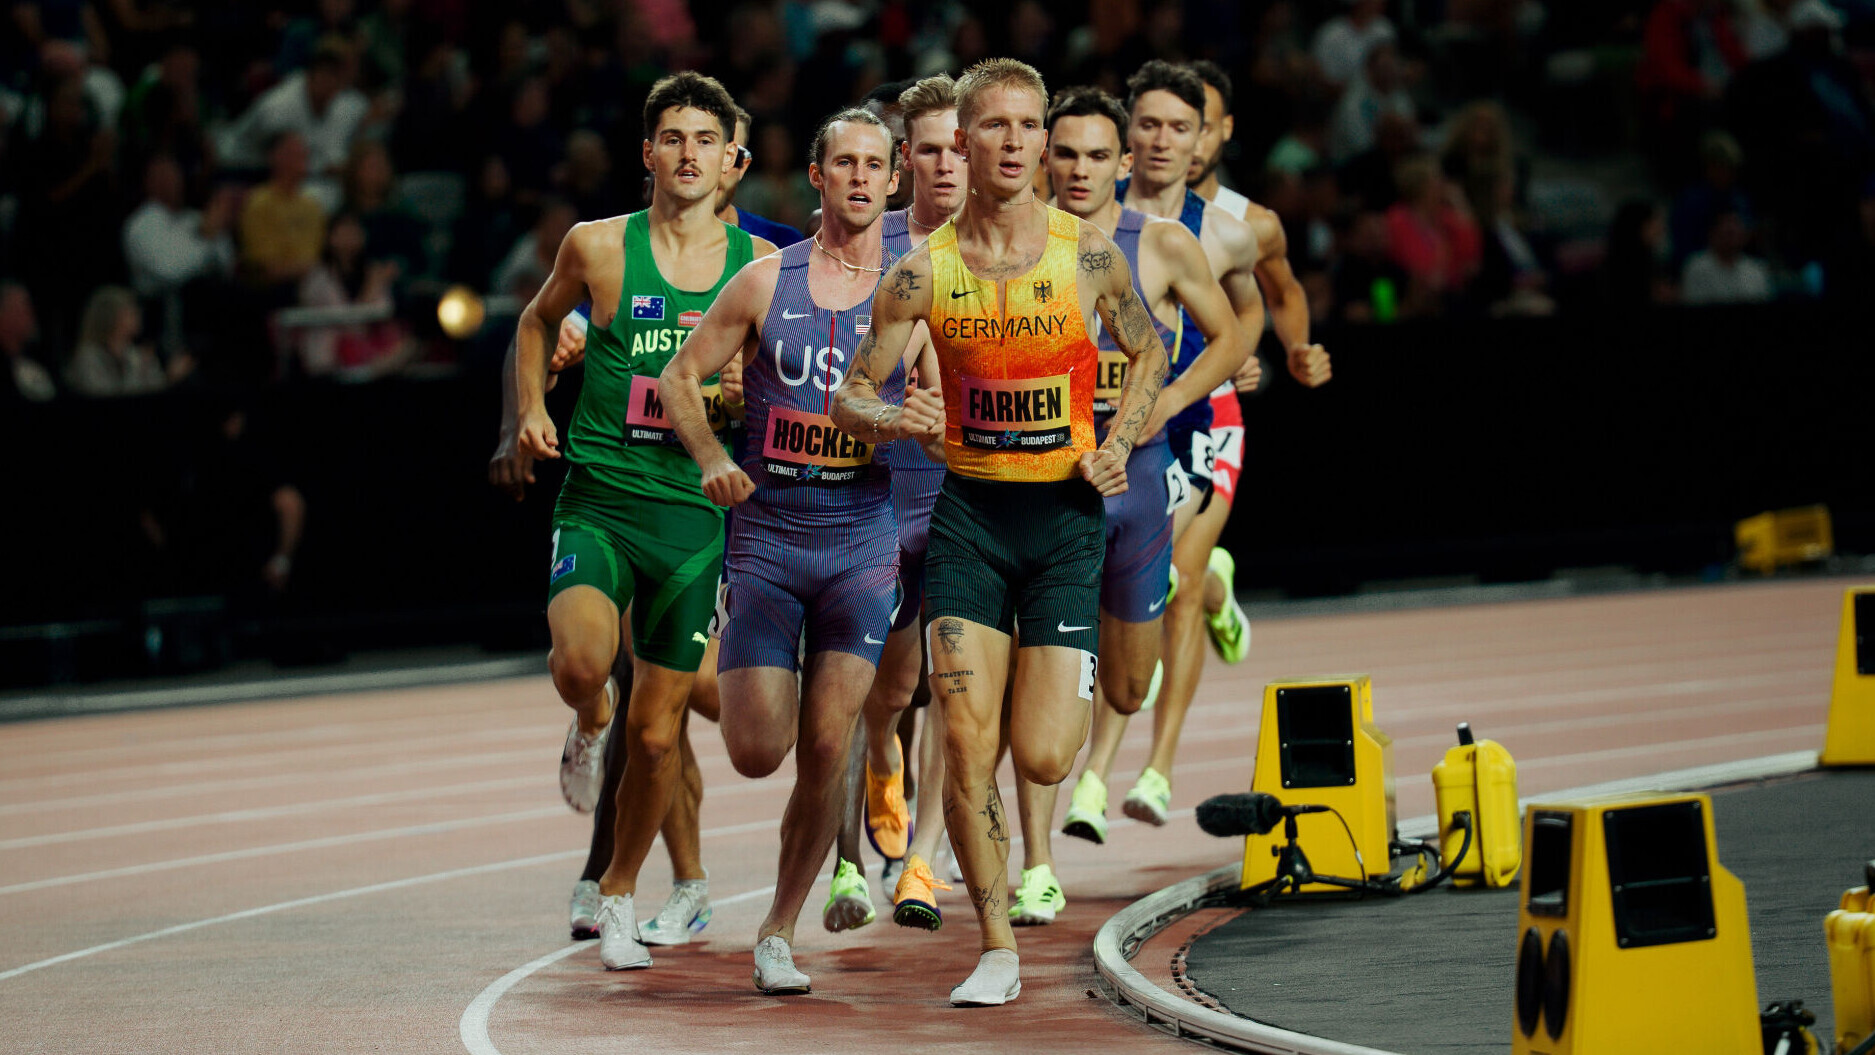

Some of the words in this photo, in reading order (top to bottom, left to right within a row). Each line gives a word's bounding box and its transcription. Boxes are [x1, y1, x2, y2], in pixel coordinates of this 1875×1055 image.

[942, 314, 1067, 338] GERMANY
[631, 328, 693, 357] AUST
[775, 339, 845, 392] US
[969, 386, 1062, 422] FARKEN
[632, 428, 664, 441] ULTIMATE
[968, 432, 997, 445] ULTIMATE
[1021, 434, 1056, 446] BUDAPEST
[767, 462, 798, 478] ULTIMATE
[821, 471, 856, 481] BUDAPEST
[1171, 473, 1185, 504] 2
[1088, 655, 1097, 694] 3
